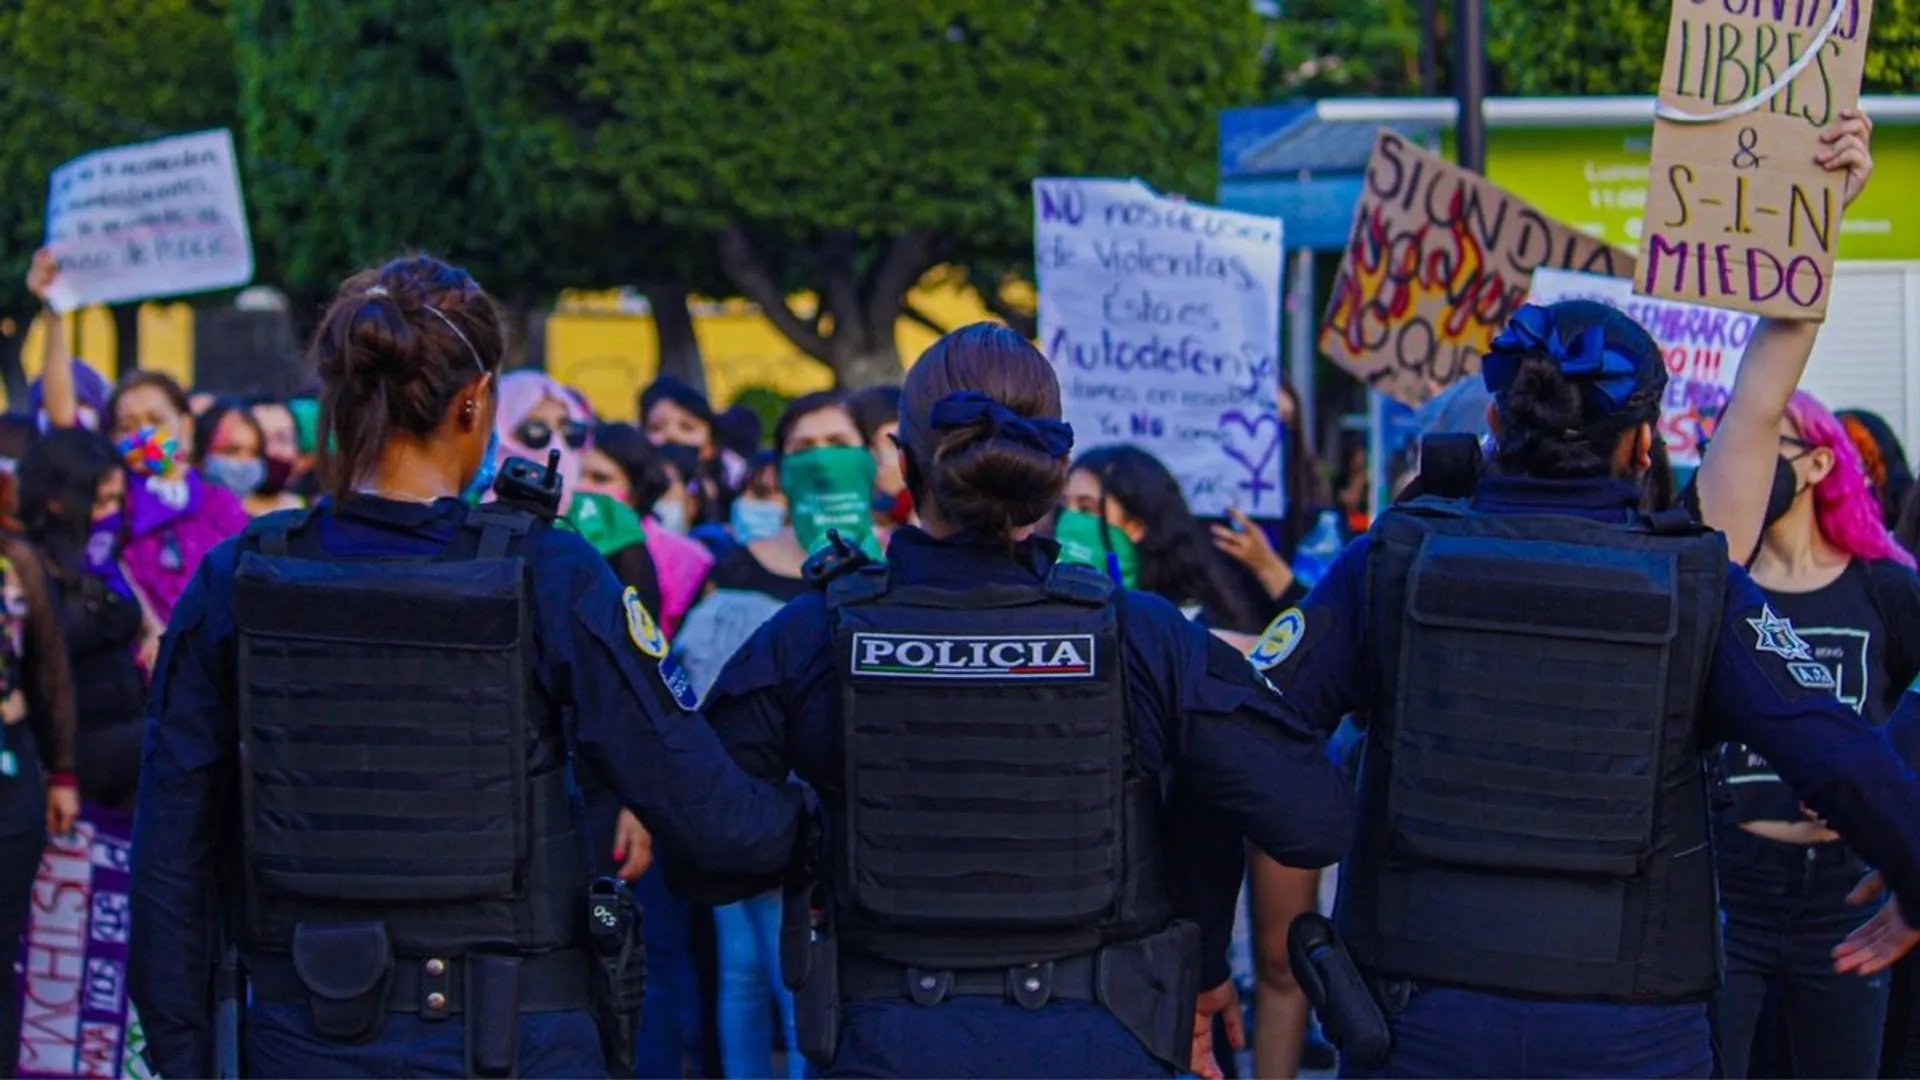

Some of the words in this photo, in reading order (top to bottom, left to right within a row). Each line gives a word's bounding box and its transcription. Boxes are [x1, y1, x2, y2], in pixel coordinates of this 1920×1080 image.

[1676, 19, 1841, 128] LIBRES
[1732, 126, 1769, 169] &
[1040, 184, 1085, 226] NO
[1644, 233, 1824, 308] MIEDO
[860, 640, 1086, 668] POLICIA
